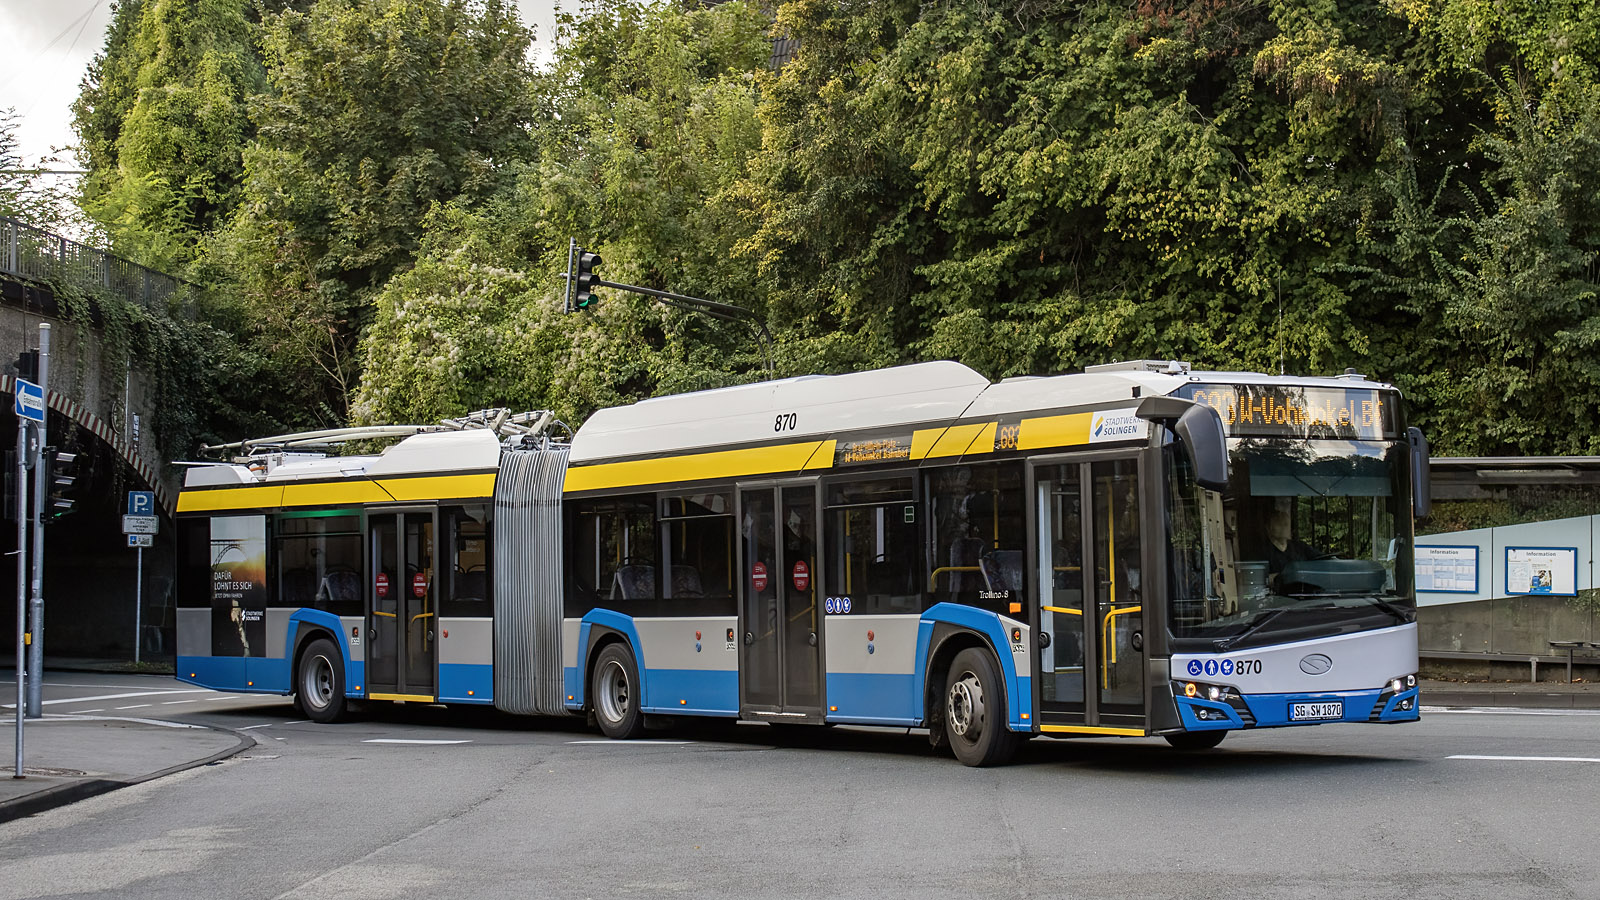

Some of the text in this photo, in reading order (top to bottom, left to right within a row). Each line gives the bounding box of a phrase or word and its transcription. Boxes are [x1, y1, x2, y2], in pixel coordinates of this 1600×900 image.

[774, 412, 797, 433] 870
[1103, 425, 1137, 436] SOLINGEN
[134, 494, 148, 513] P
[214, 570, 232, 580] DAFÜR
[214, 581, 252, 590] LOHNT ES SICH
[1235, 659, 1262, 675] 870
[1295, 704, 1342, 717] SG SW 1870
